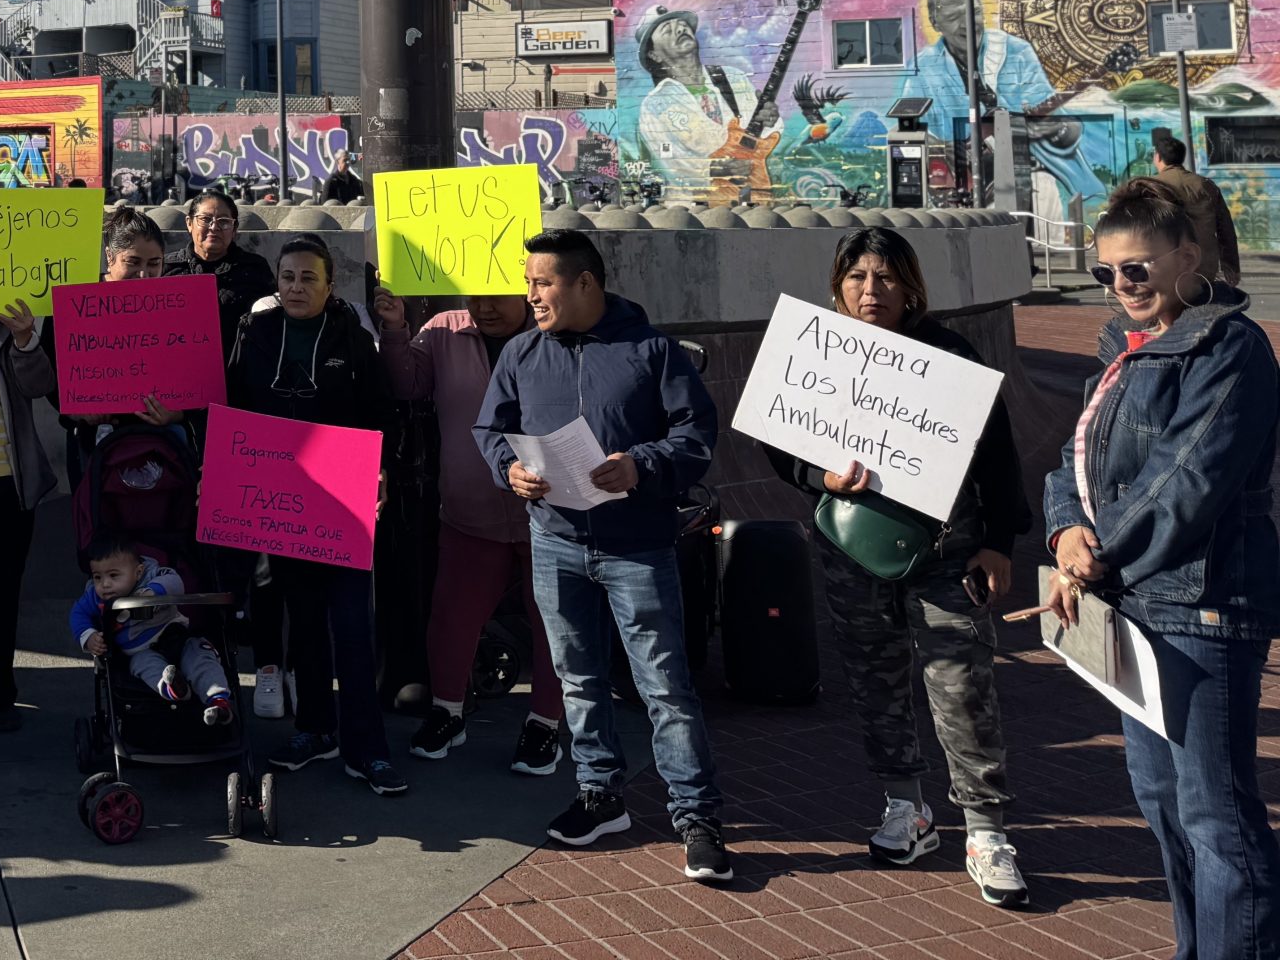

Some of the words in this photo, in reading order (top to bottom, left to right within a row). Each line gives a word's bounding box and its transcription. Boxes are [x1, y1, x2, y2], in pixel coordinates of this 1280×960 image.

[524, 37, 600, 52] Garden
[536, 28, 587, 41] Beer
[384, 174, 451, 222] Let
[71, 293, 186, 318] VENDEDORES
[68, 333, 160, 352] AMBULANTES
[192, 331, 210, 345] LA
[797, 315, 904, 376] Apoyen
[70, 364, 124, 383] MISSION
[784, 355, 837, 395] Los
[852, 377, 959, 443] Vendedores
[231, 430, 296, 468] Pagamos
[768, 393, 923, 477] Ambulantes
[237, 484, 306, 514] TAXES
[212, 508, 253, 528] Somos
[257, 516, 308, 536] FAMILIA
[314, 524, 344, 541] QUE
[201, 527, 284, 551] NECESITAMOS
[290, 541, 353, 563] TRABAJAR
